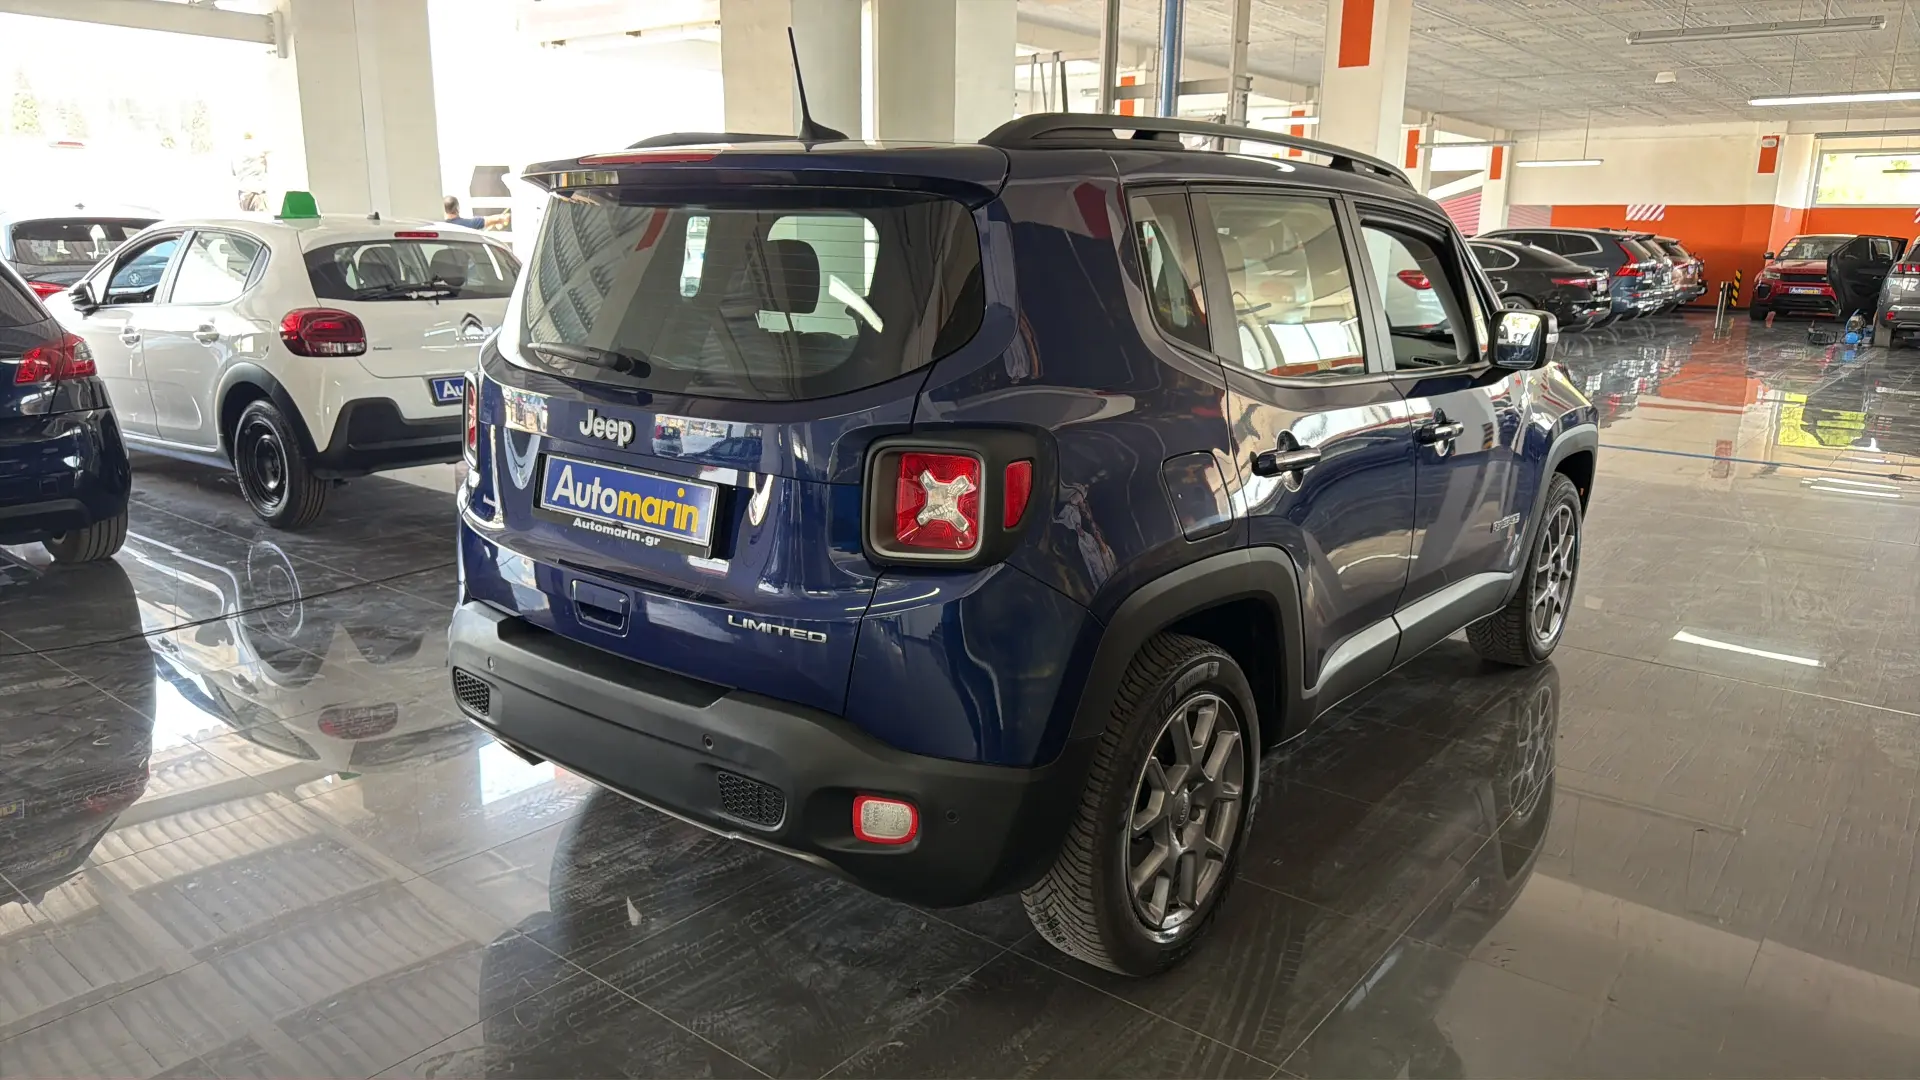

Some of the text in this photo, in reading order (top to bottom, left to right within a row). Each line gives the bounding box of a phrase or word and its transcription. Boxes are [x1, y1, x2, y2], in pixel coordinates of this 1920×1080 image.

[443, 381, 463, 398] Au
[579, 408, 634, 448] Jeep
[552, 464, 700, 533] Automarin
[573, 517, 660, 546] Automarin.gr
[728, 614, 827, 643] LIMITED
